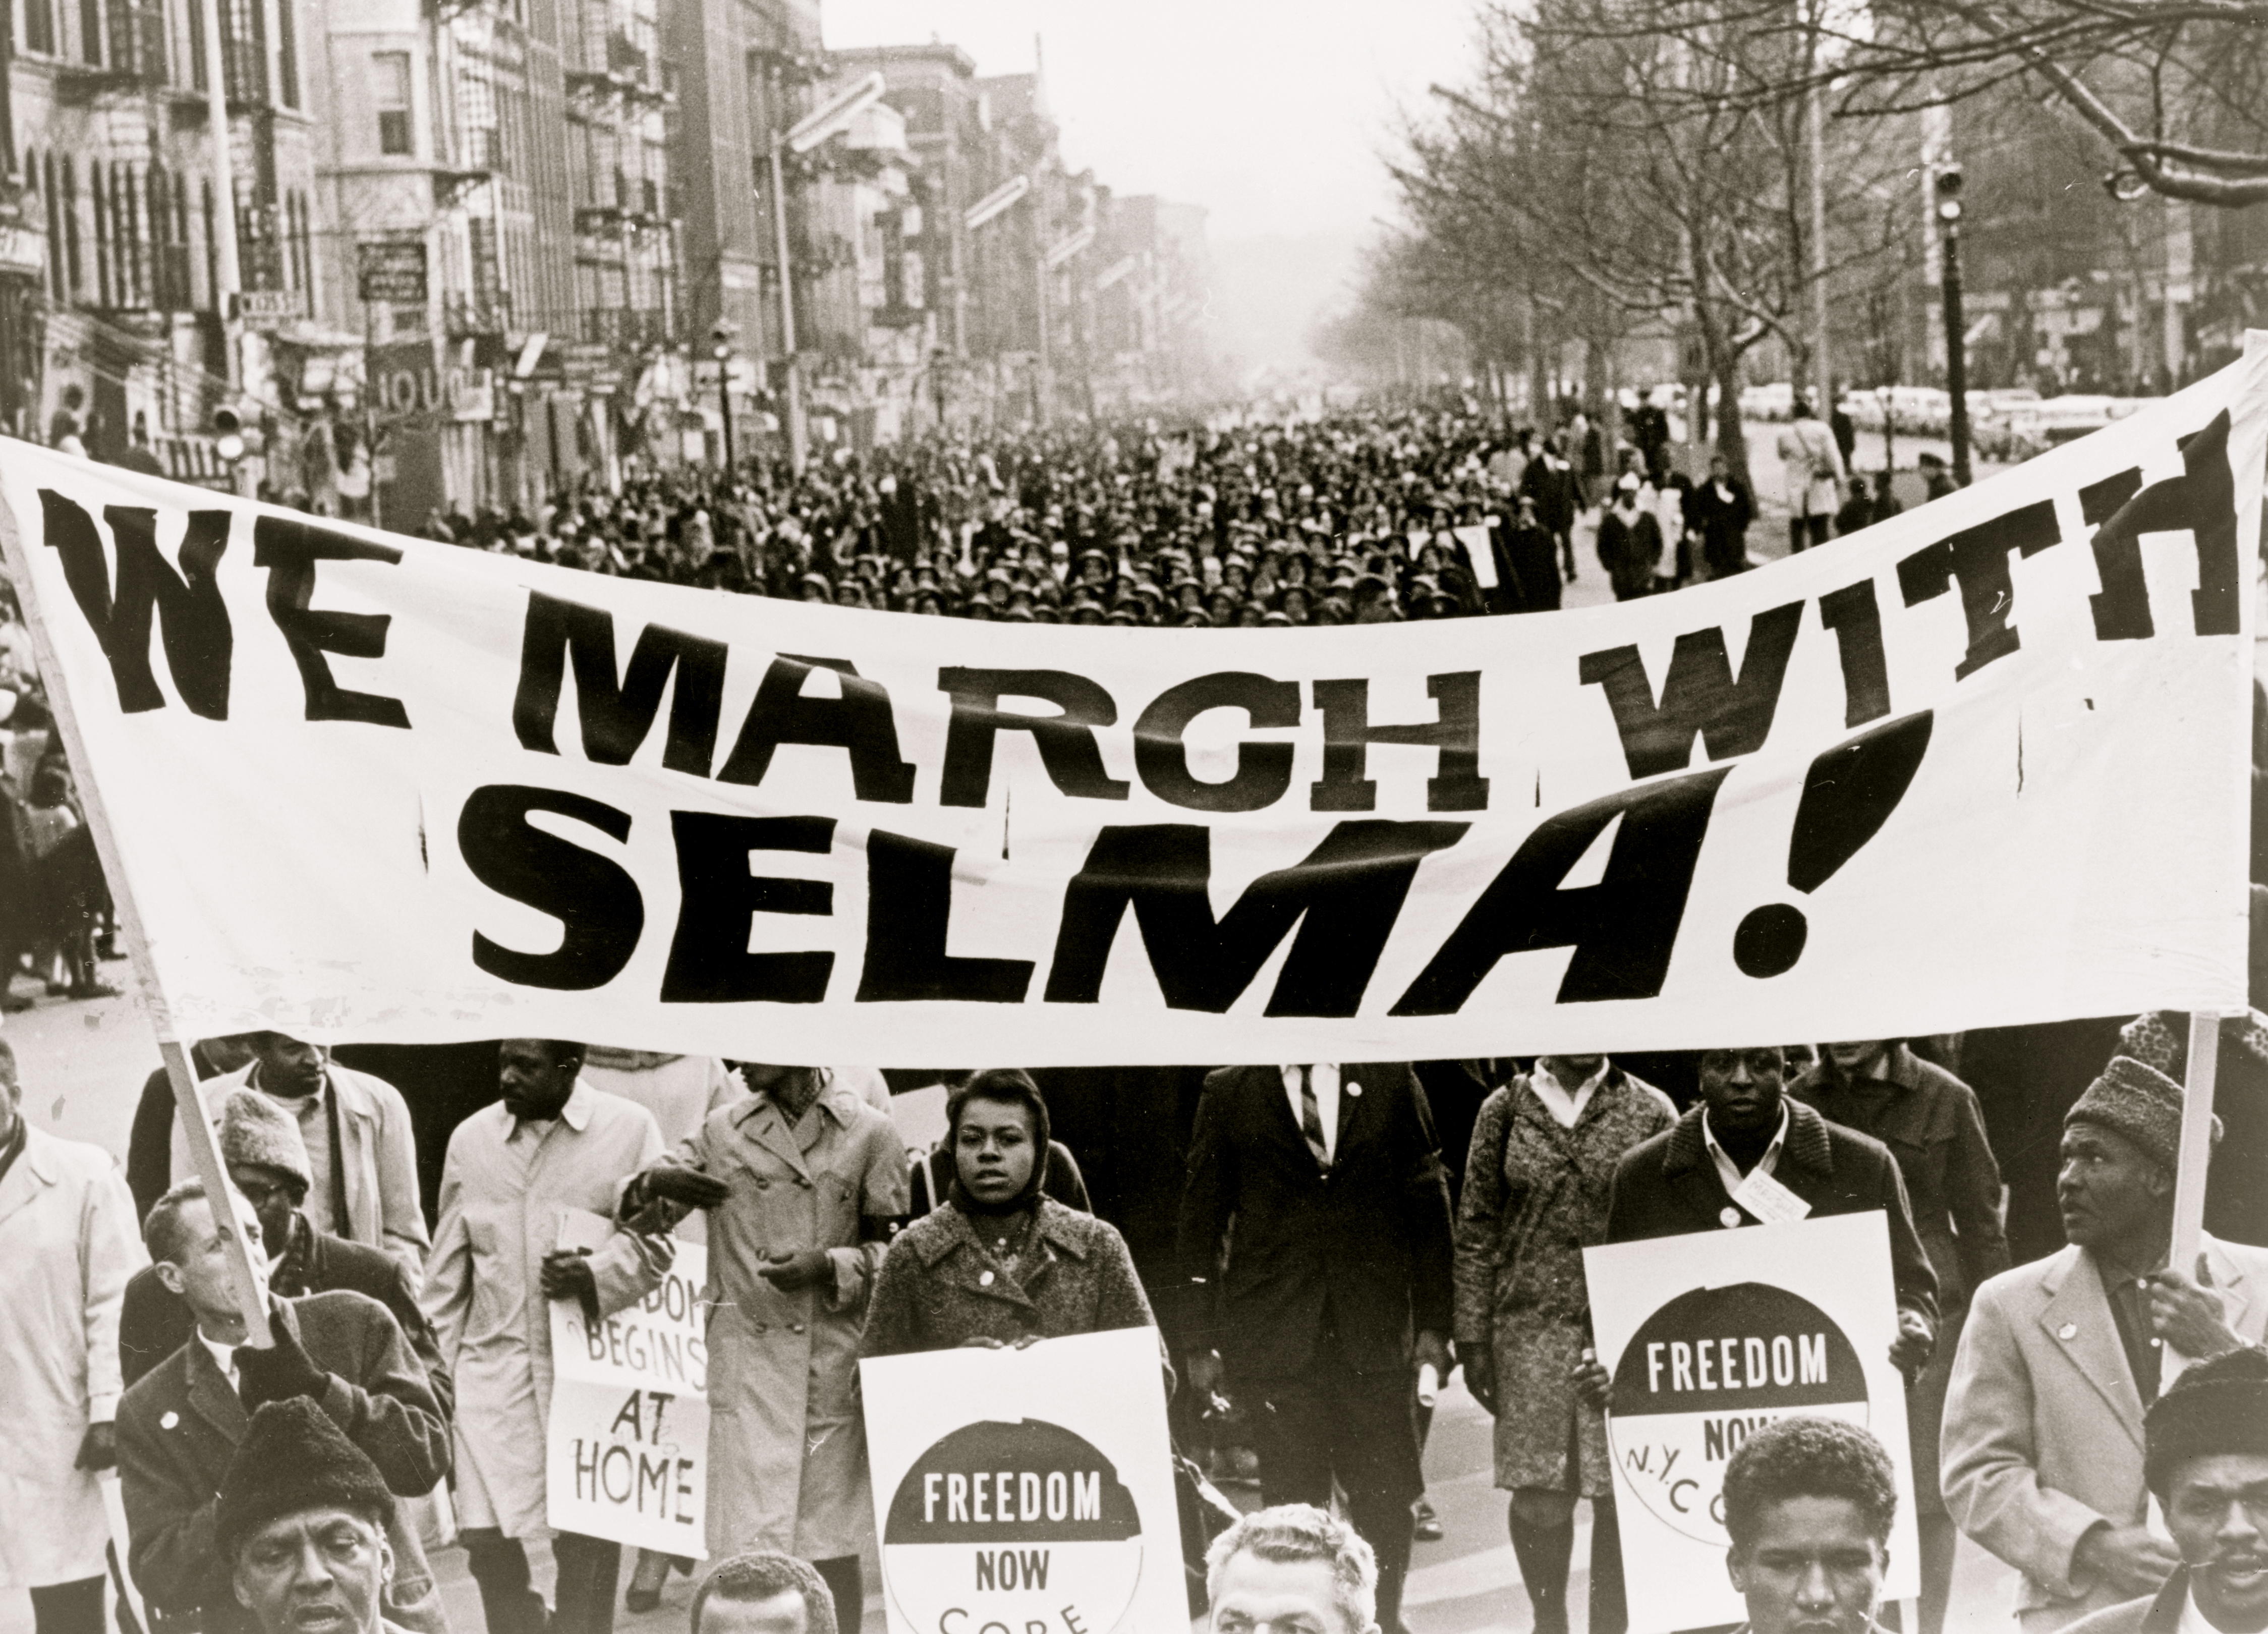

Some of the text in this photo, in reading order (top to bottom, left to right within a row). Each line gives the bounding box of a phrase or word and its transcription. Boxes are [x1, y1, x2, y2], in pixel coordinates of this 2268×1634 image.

[37, 407, 2241, 812] WE MARCH WITH
[457, 708, 1935, 1017] SELMA!
[586, 1319, 708, 1391] BEGINS
[1647, 1333, 1828, 1393] FREEDOM
[610, 1388, 675, 1445] AT
[1704, 1416, 1778, 1461] NO
[575, 1438, 694, 1525] HOME
[923, 1470, 1101, 1523] FREEDOM
[976, 1550, 1050, 1591] NOW
